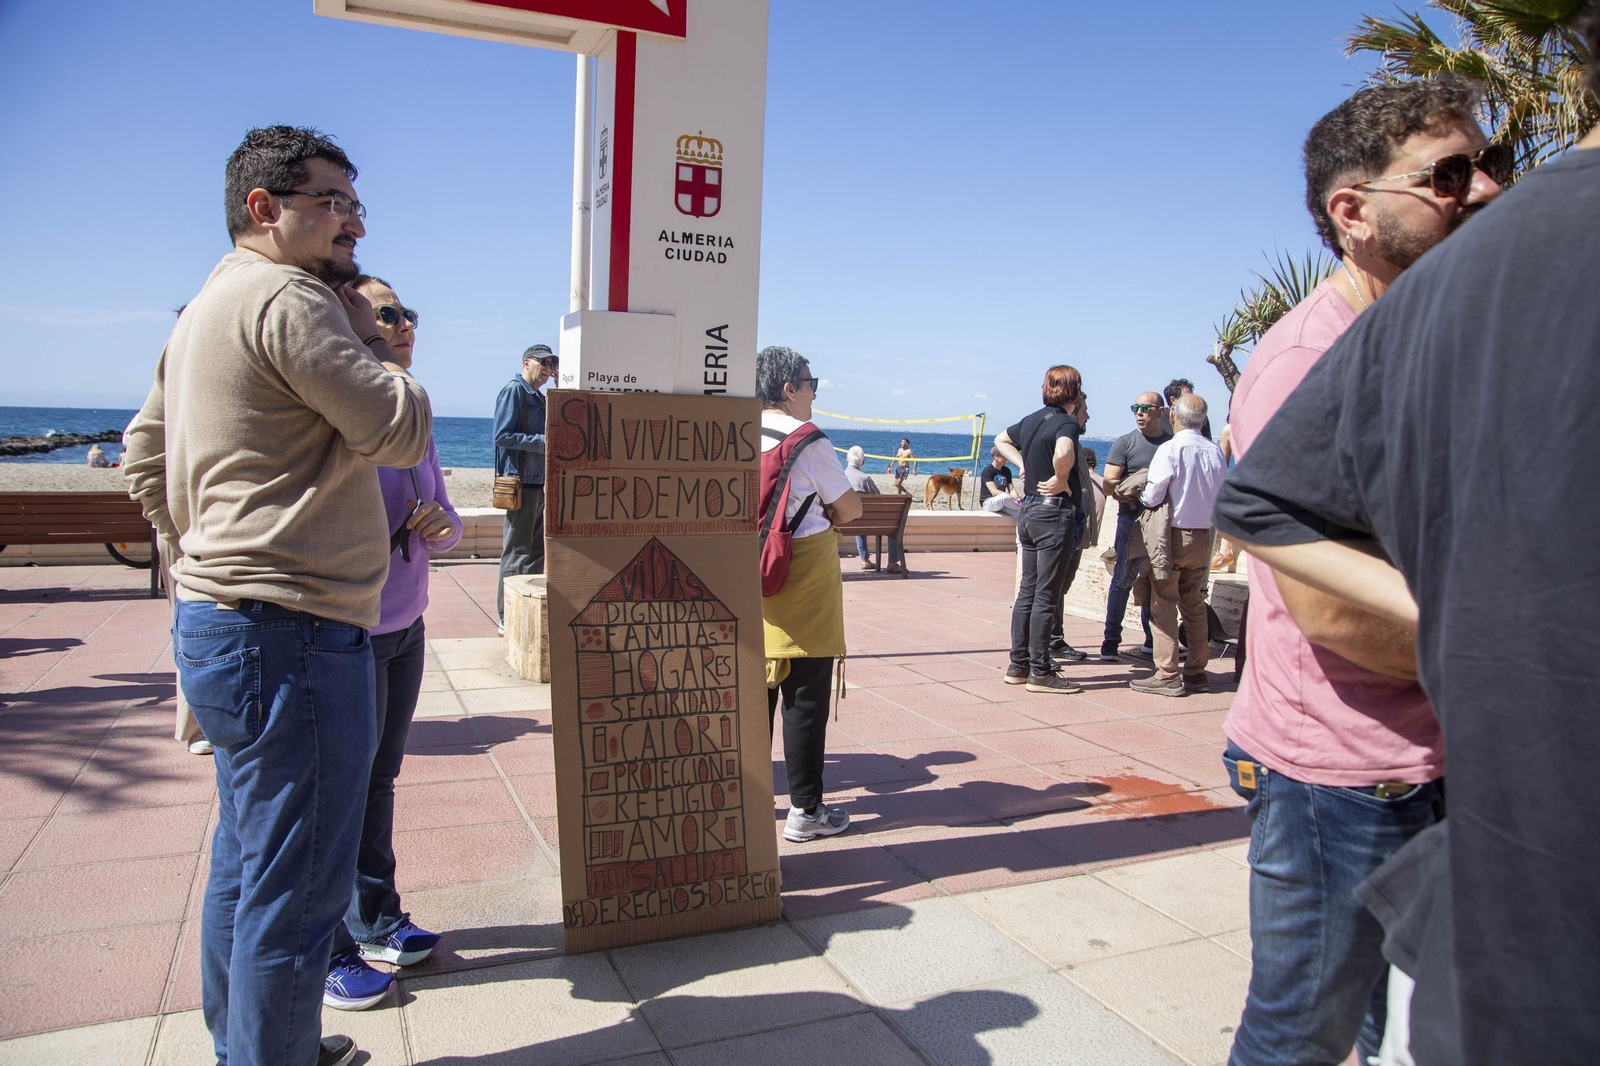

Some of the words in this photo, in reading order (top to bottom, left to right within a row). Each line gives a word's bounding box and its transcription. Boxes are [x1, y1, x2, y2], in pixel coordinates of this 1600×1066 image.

[658, 230, 735, 249] ALMERIA
[664, 248, 728, 264] CIUDAD
[588, 372, 620, 384] Playa
[623, 374, 637, 383] de
[703, 324, 729, 396] ERIA
[556, 398, 612, 461] SIN
[621, 415, 756, 462] VIVIENDAS
[559, 470, 747, 532] ¡PERDEMOS!
[620, 544, 704, 600] VIDAS
[606, 601, 715, 624] DIGNIDAD
[611, 647, 732, 696] HOGARES
[610, 690, 721, 721] SEGURIDAD
[621, 716, 720, 762] CALOR
[615, 782, 725, 822] REFUGIO
[627, 811, 727, 862] AMOR
[630, 854, 715, 891] SALUD
